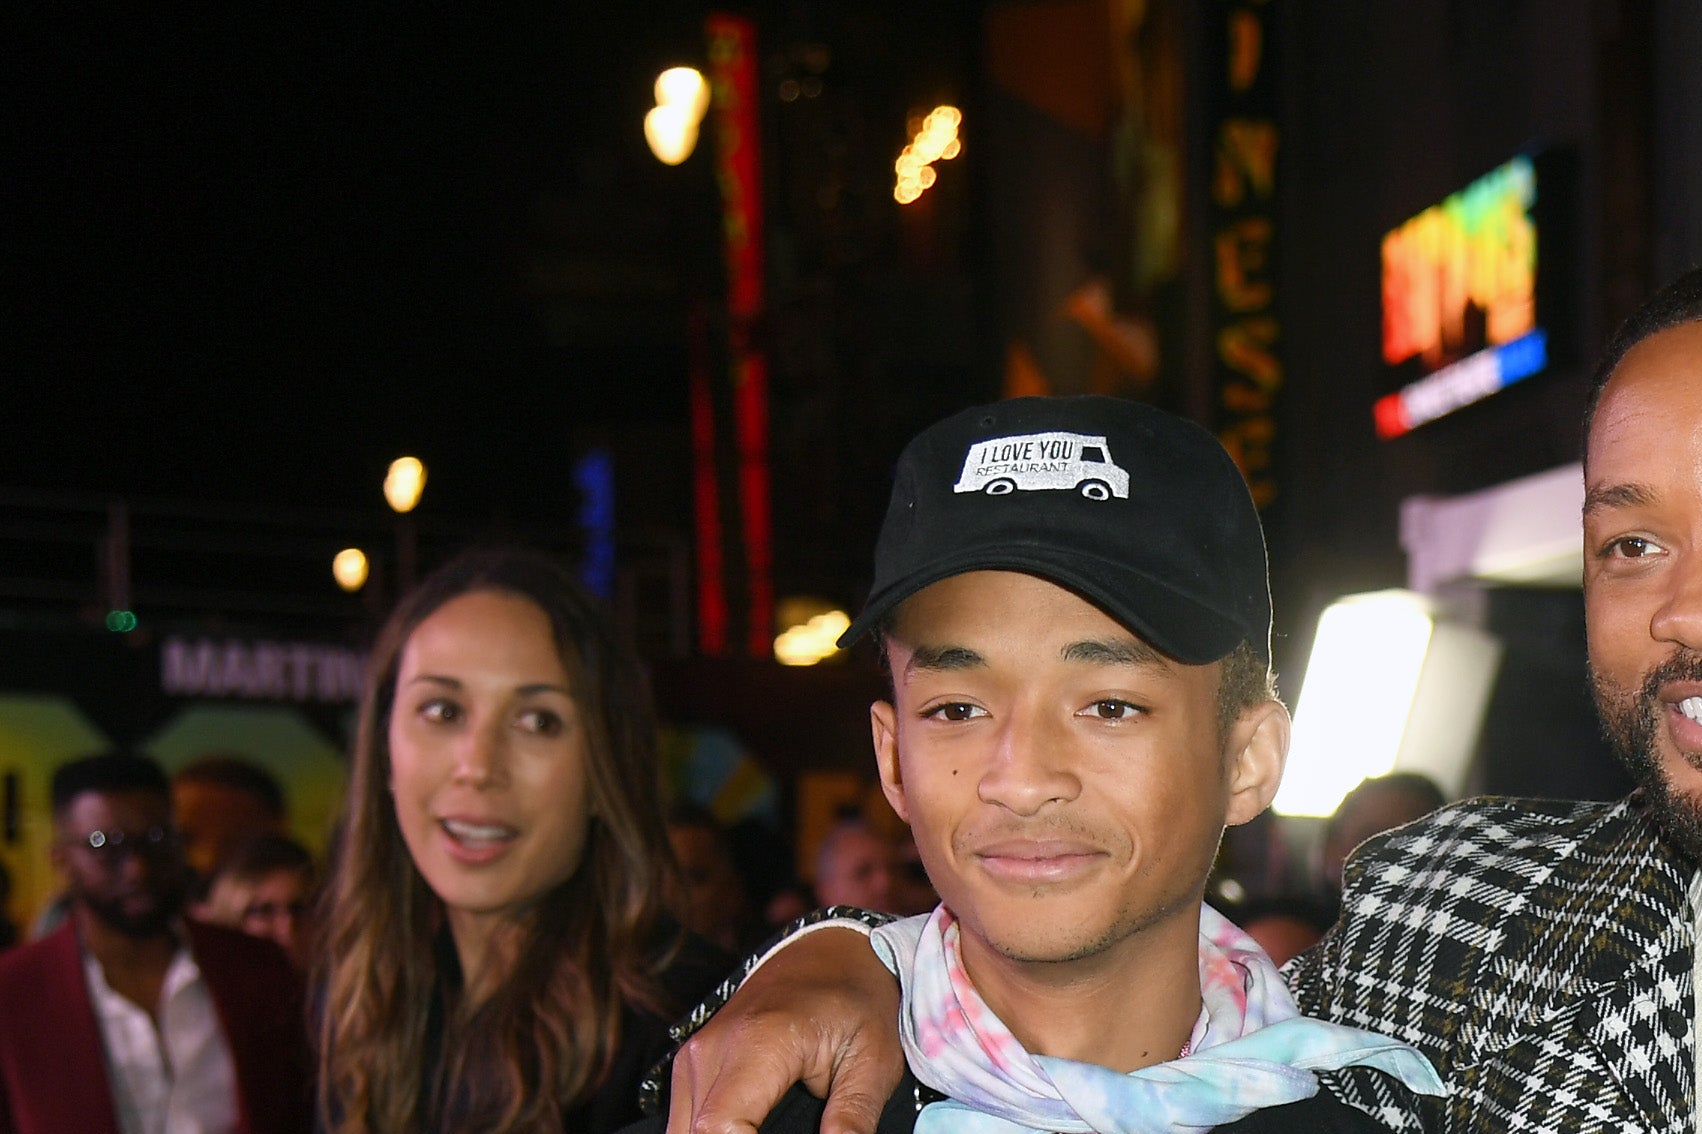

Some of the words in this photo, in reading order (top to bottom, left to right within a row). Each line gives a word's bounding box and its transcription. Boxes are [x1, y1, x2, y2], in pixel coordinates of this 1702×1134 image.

[980, 447, 988, 465] I
[991, 442, 1034, 463] LOVE
[1040, 440, 1074, 460] YOU
[975, 461, 1071, 476] RESTAURANT
